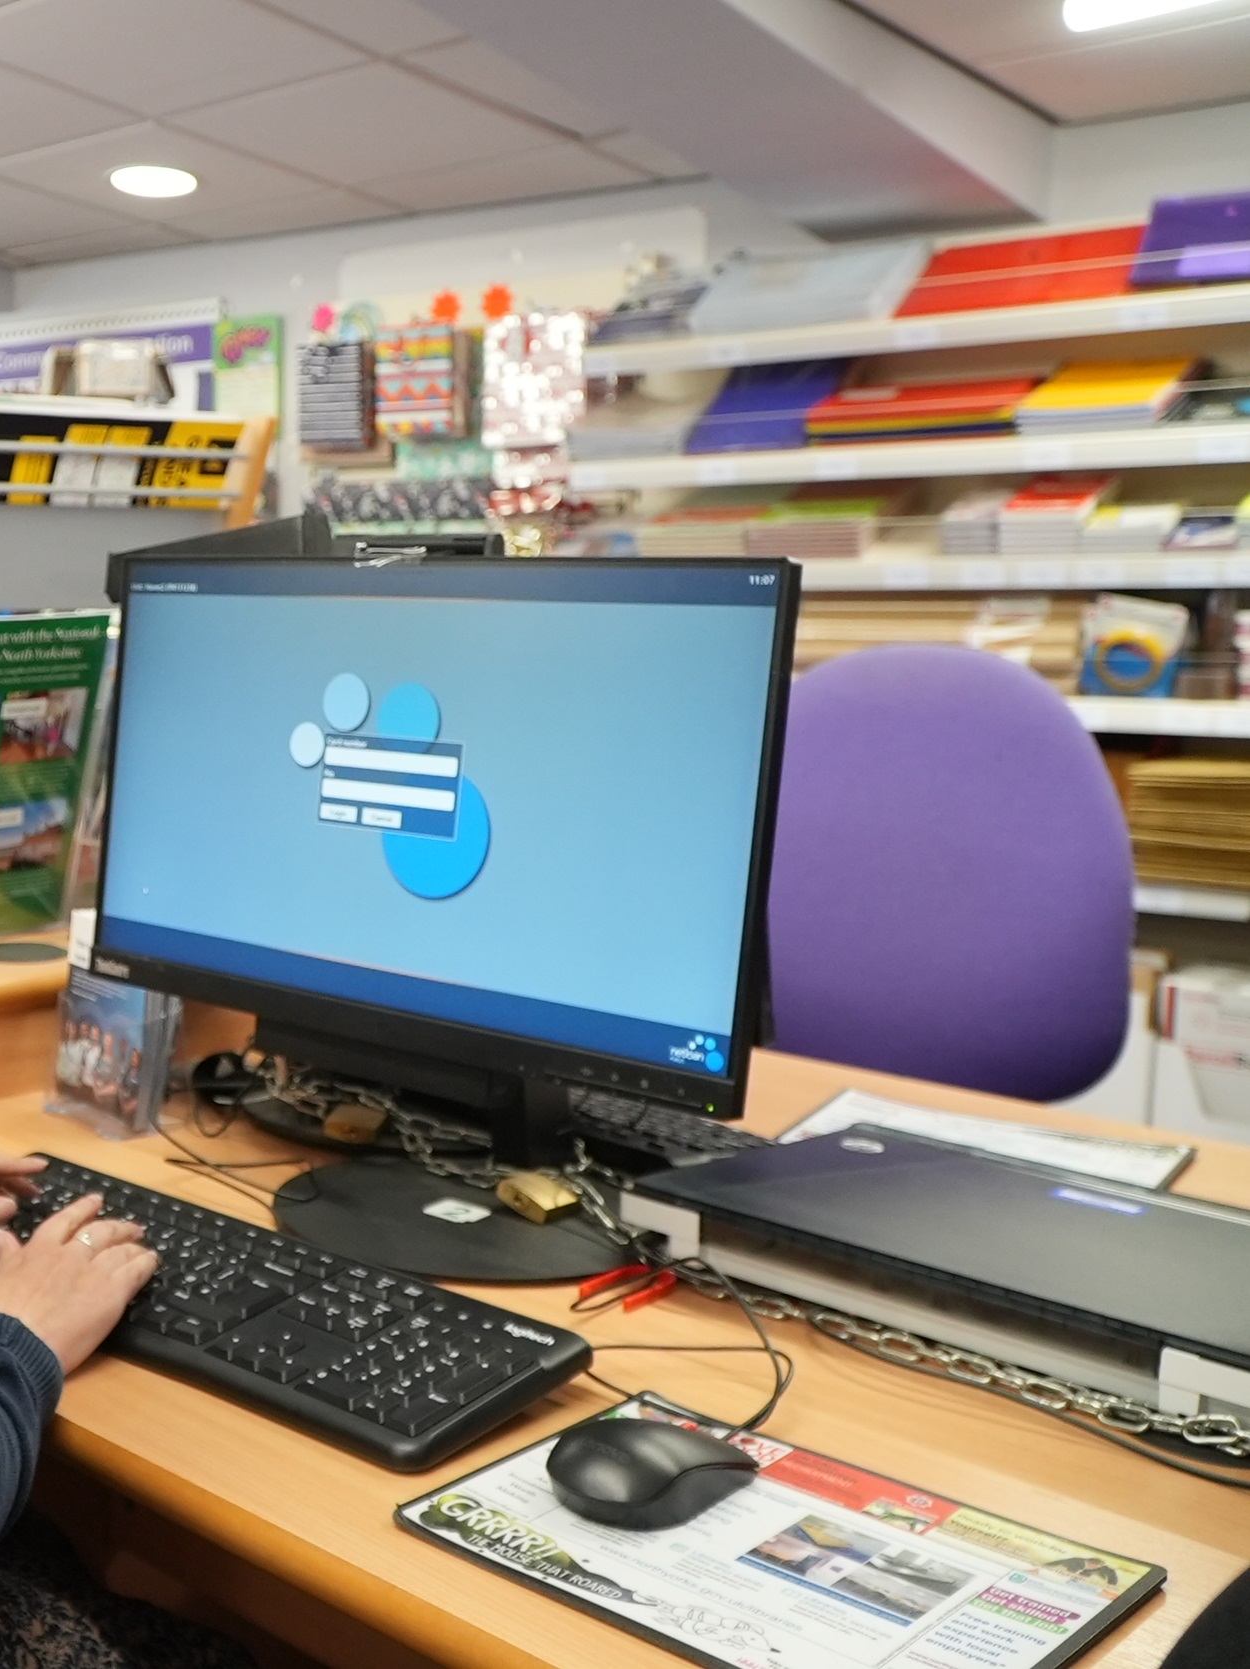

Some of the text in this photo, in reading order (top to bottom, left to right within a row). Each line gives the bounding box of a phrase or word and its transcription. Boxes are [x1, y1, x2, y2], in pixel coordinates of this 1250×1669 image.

[749, 575, 775, 586] 11:07
[467, 1534, 623, 1600] THE MOUSE THAT ROARED
[979, 1593, 1058, 1623] Get skilled
[988, 1586, 1071, 1619] Get trained
[934, 1630, 1002, 1658] with local
[942, 1624, 1020, 1655] experience
[950, 1618, 1015, 1644] and work
[959, 1611, 1048, 1647] Free training
